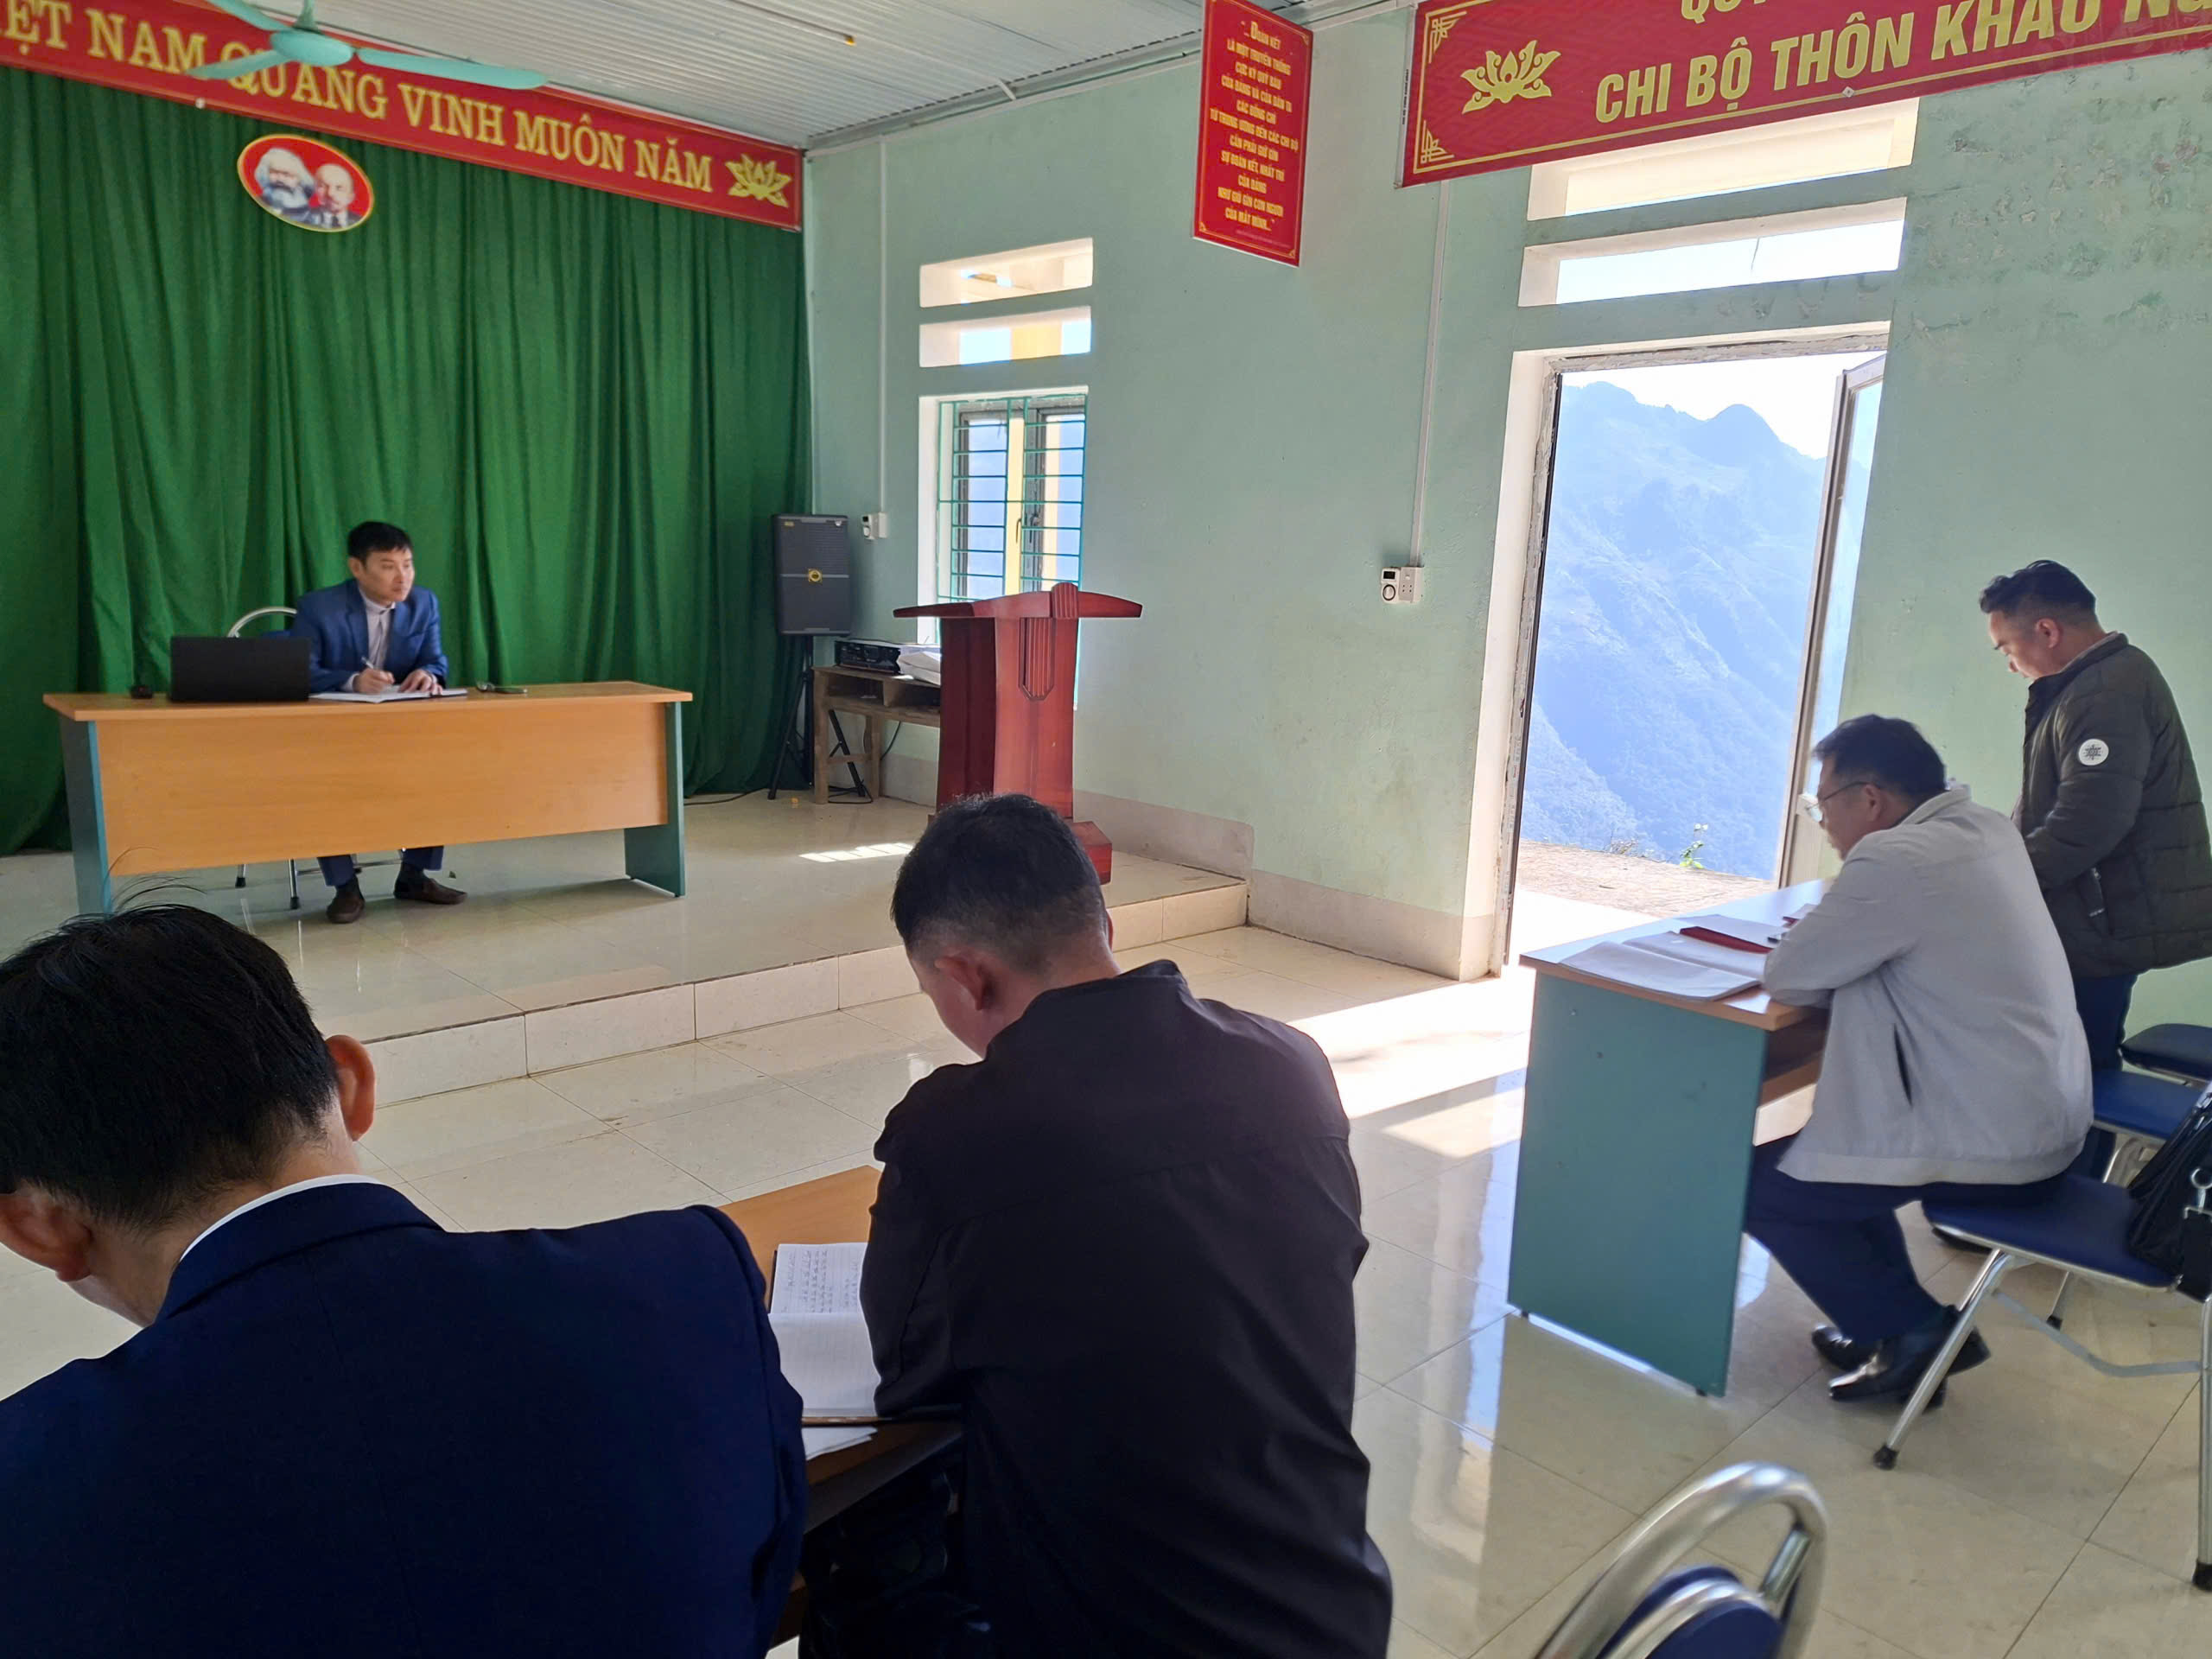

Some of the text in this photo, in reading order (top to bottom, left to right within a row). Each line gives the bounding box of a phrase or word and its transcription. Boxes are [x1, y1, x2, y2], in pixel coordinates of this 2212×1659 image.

[85, 7, 207, 80] NAM
[221, 41, 388, 119] QUANG
[397, 83, 505, 147] VINH
[513, 113, 625, 173] MUÔN
[634, 137, 714, 193] NĂM
[1595, 63, 1672, 123] CHI
[1685, 36, 1753, 111] BỘ
[1770, 11, 1915, 91] THÔN
